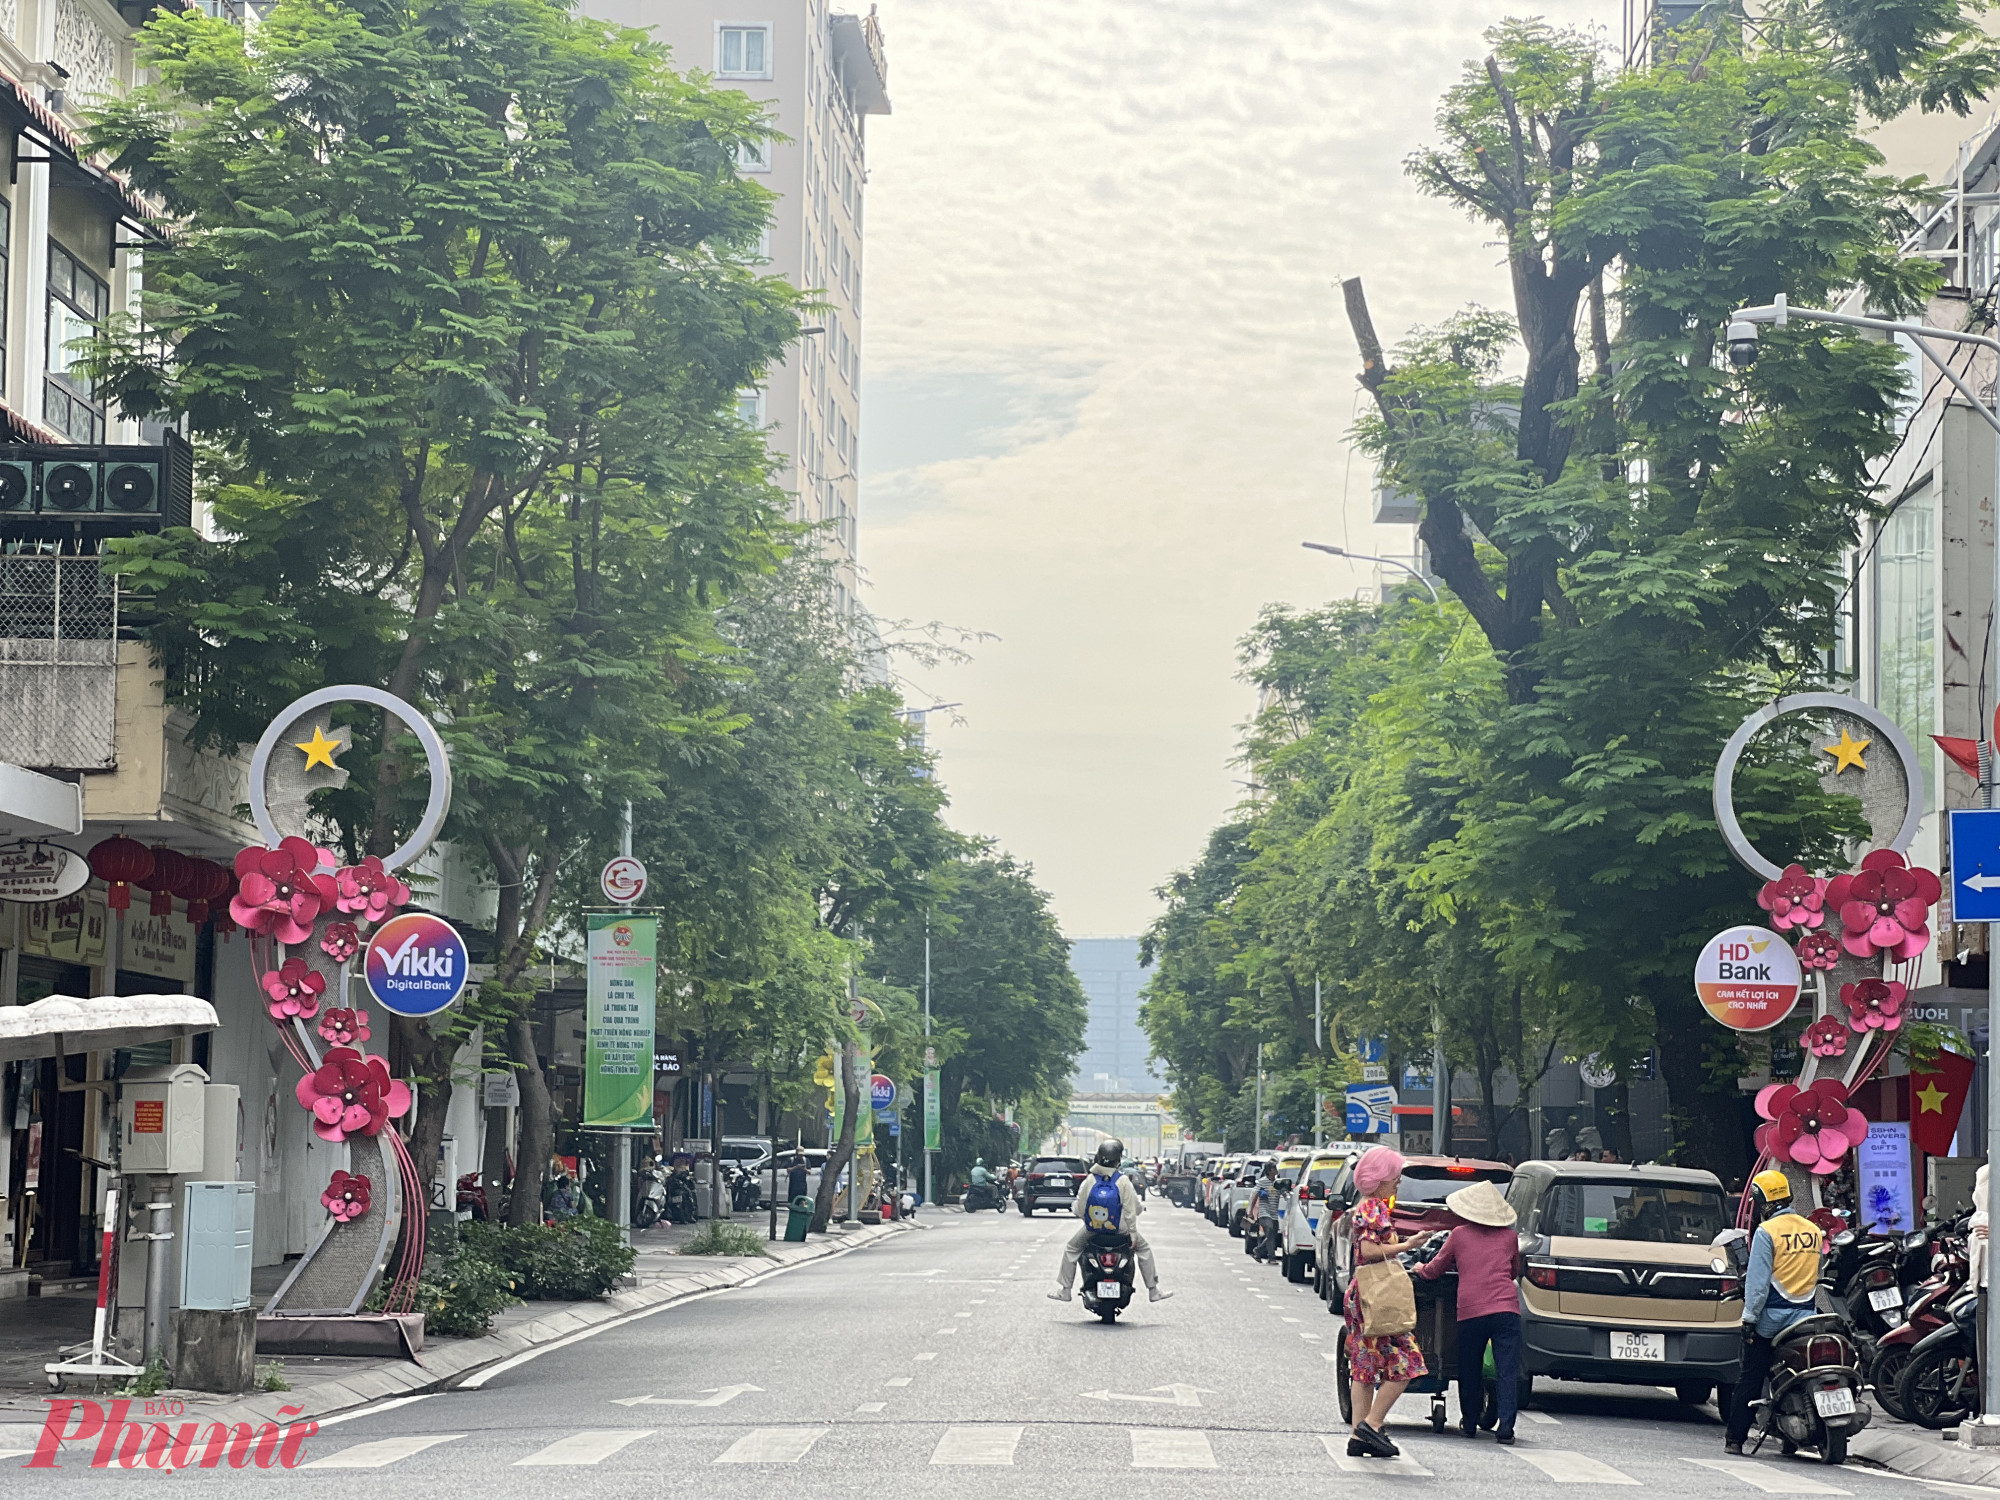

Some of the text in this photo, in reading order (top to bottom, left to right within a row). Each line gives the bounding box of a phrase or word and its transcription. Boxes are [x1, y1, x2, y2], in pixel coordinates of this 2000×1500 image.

[375, 933, 454, 978] Vikki
[1719, 943, 1750, 961] HD
[1719, 962, 1771, 981] Bank
[386, 979, 451, 992] Digital Bank
[1728, 1001, 1745, 1009] CAO
[1875, 1296, 1898, 1309] 7075
[1626, 1334, 1649, 1347] 60C
[1616, 1346, 1658, 1359] 709.44
